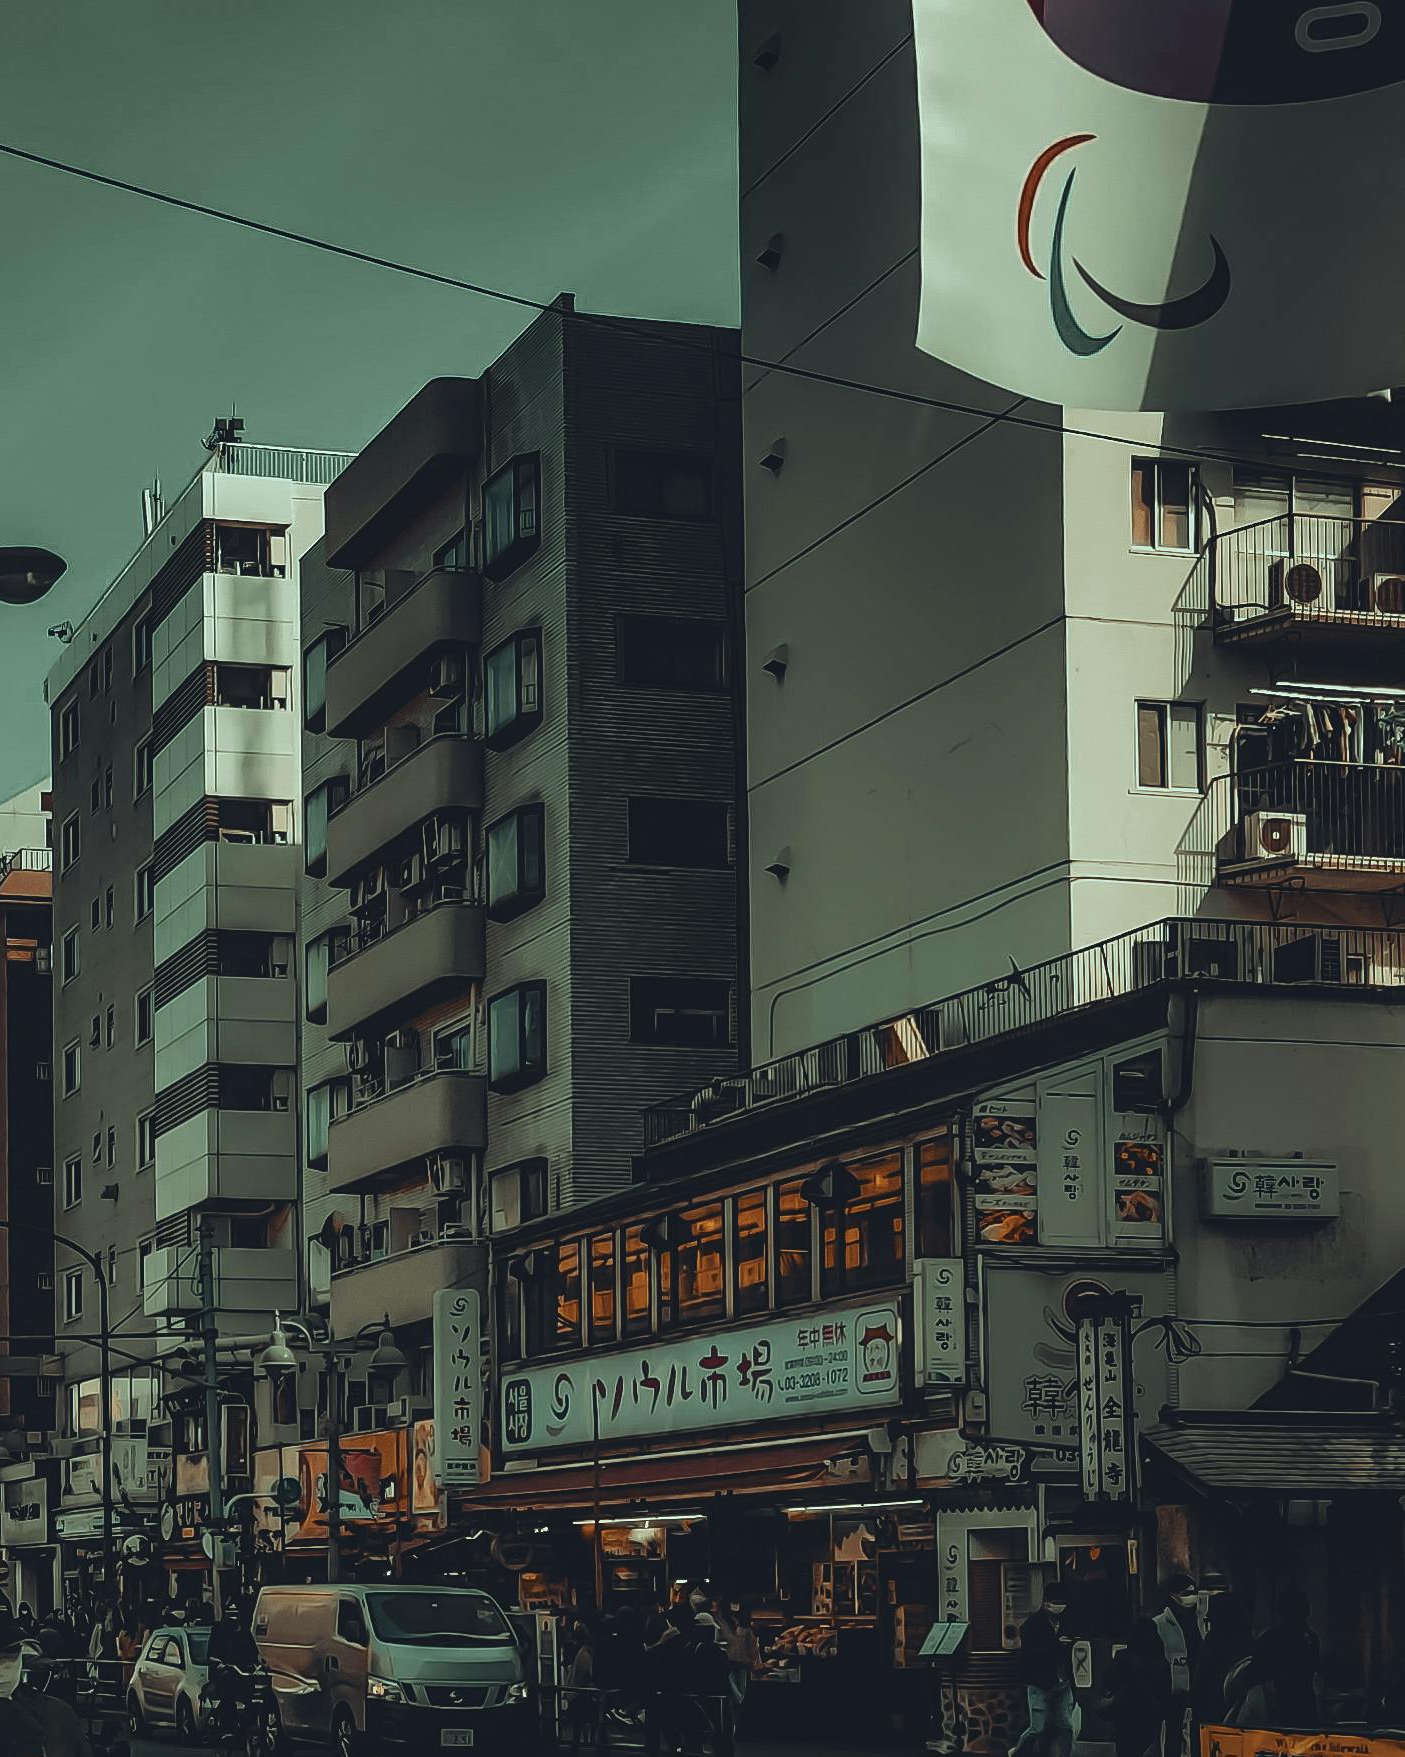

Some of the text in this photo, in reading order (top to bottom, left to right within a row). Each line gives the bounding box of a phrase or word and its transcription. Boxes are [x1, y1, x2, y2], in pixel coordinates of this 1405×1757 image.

[1254, 1175, 1325, 1200] 韓사랑
[935, 1296, 953, 1351] 韓사랑
[450, 1324, 472, 1448] ソウル市場
[508, 1385, 529, 1412] 서울
[596, 1338, 774, 1423] ソウル市場
[508, 1412, 529, 1440] 시장
